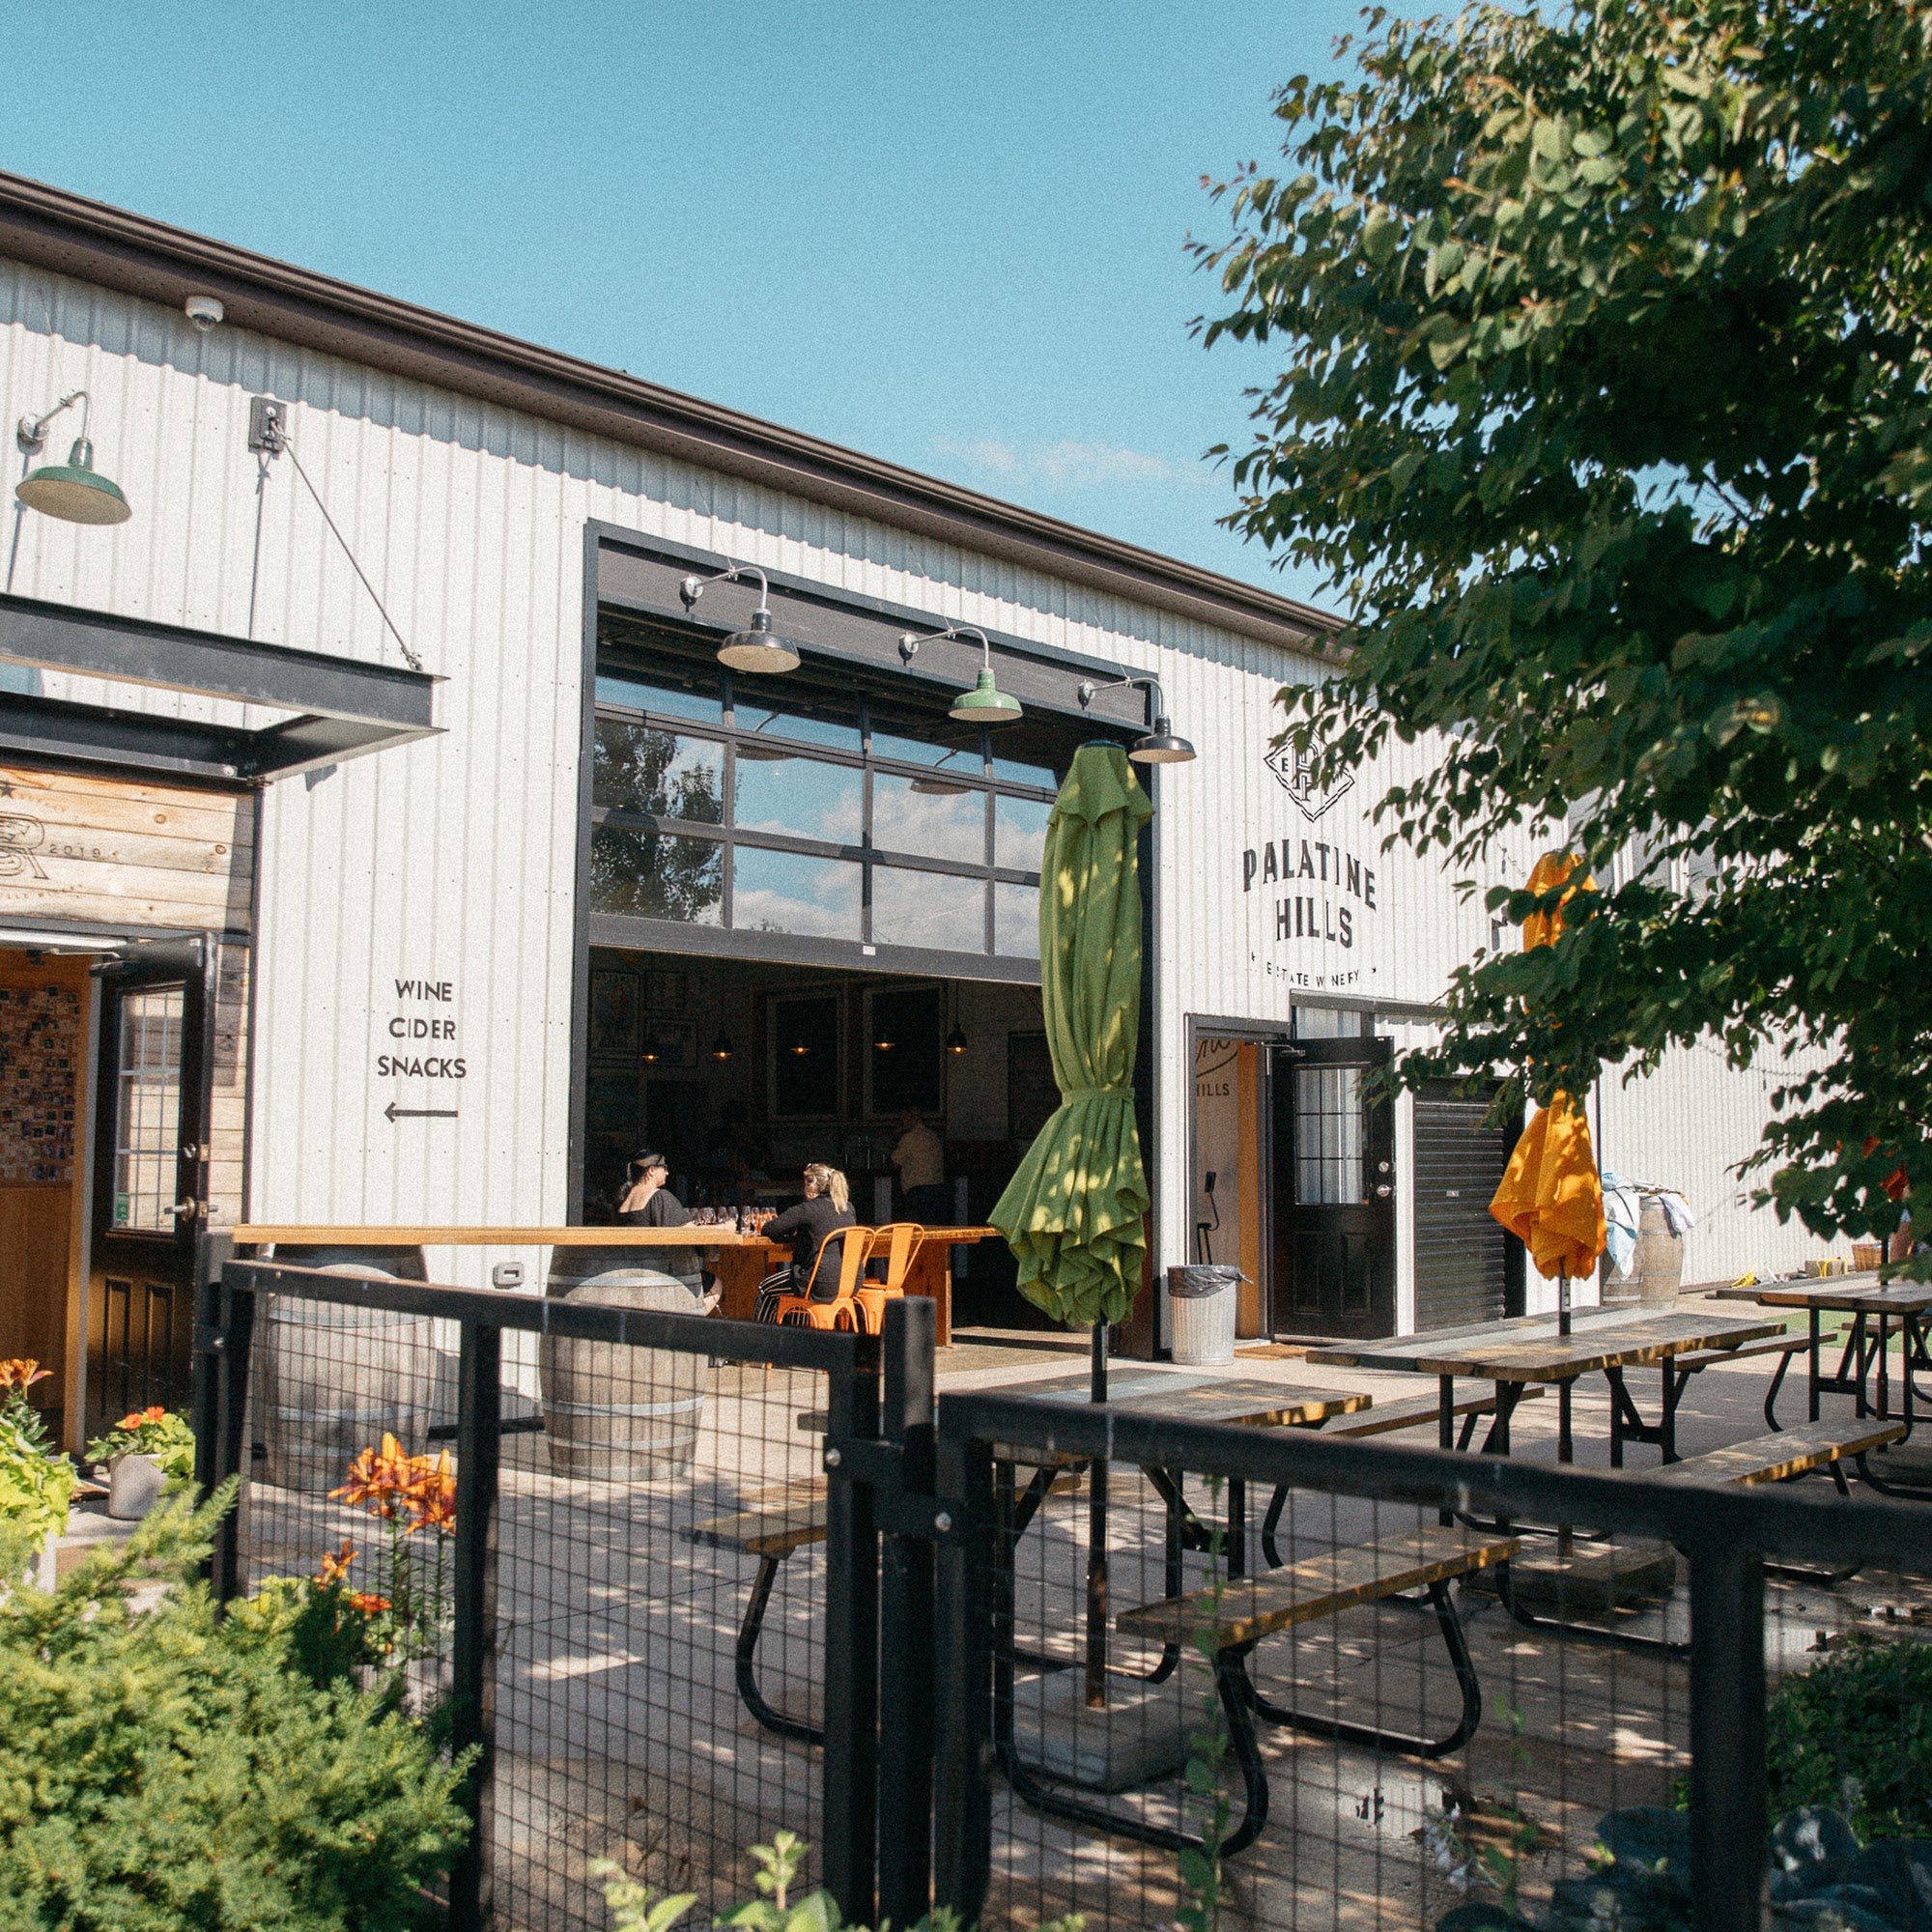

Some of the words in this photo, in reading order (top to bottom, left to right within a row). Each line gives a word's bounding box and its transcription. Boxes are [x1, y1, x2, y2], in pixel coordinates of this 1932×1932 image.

[48, 843, 101, 858] 2019
[1243, 838, 1377, 911] PALATINE
[1276, 895, 1353, 949] HILLS
[1316, 969, 1359, 987] WNERY
[395, 979, 453, 1002] WINE
[388, 1017, 457, 1040] CIDER
[378, 1055, 468, 1079] SNACKS
[1196, 1083, 1230, 1096] ILLS
